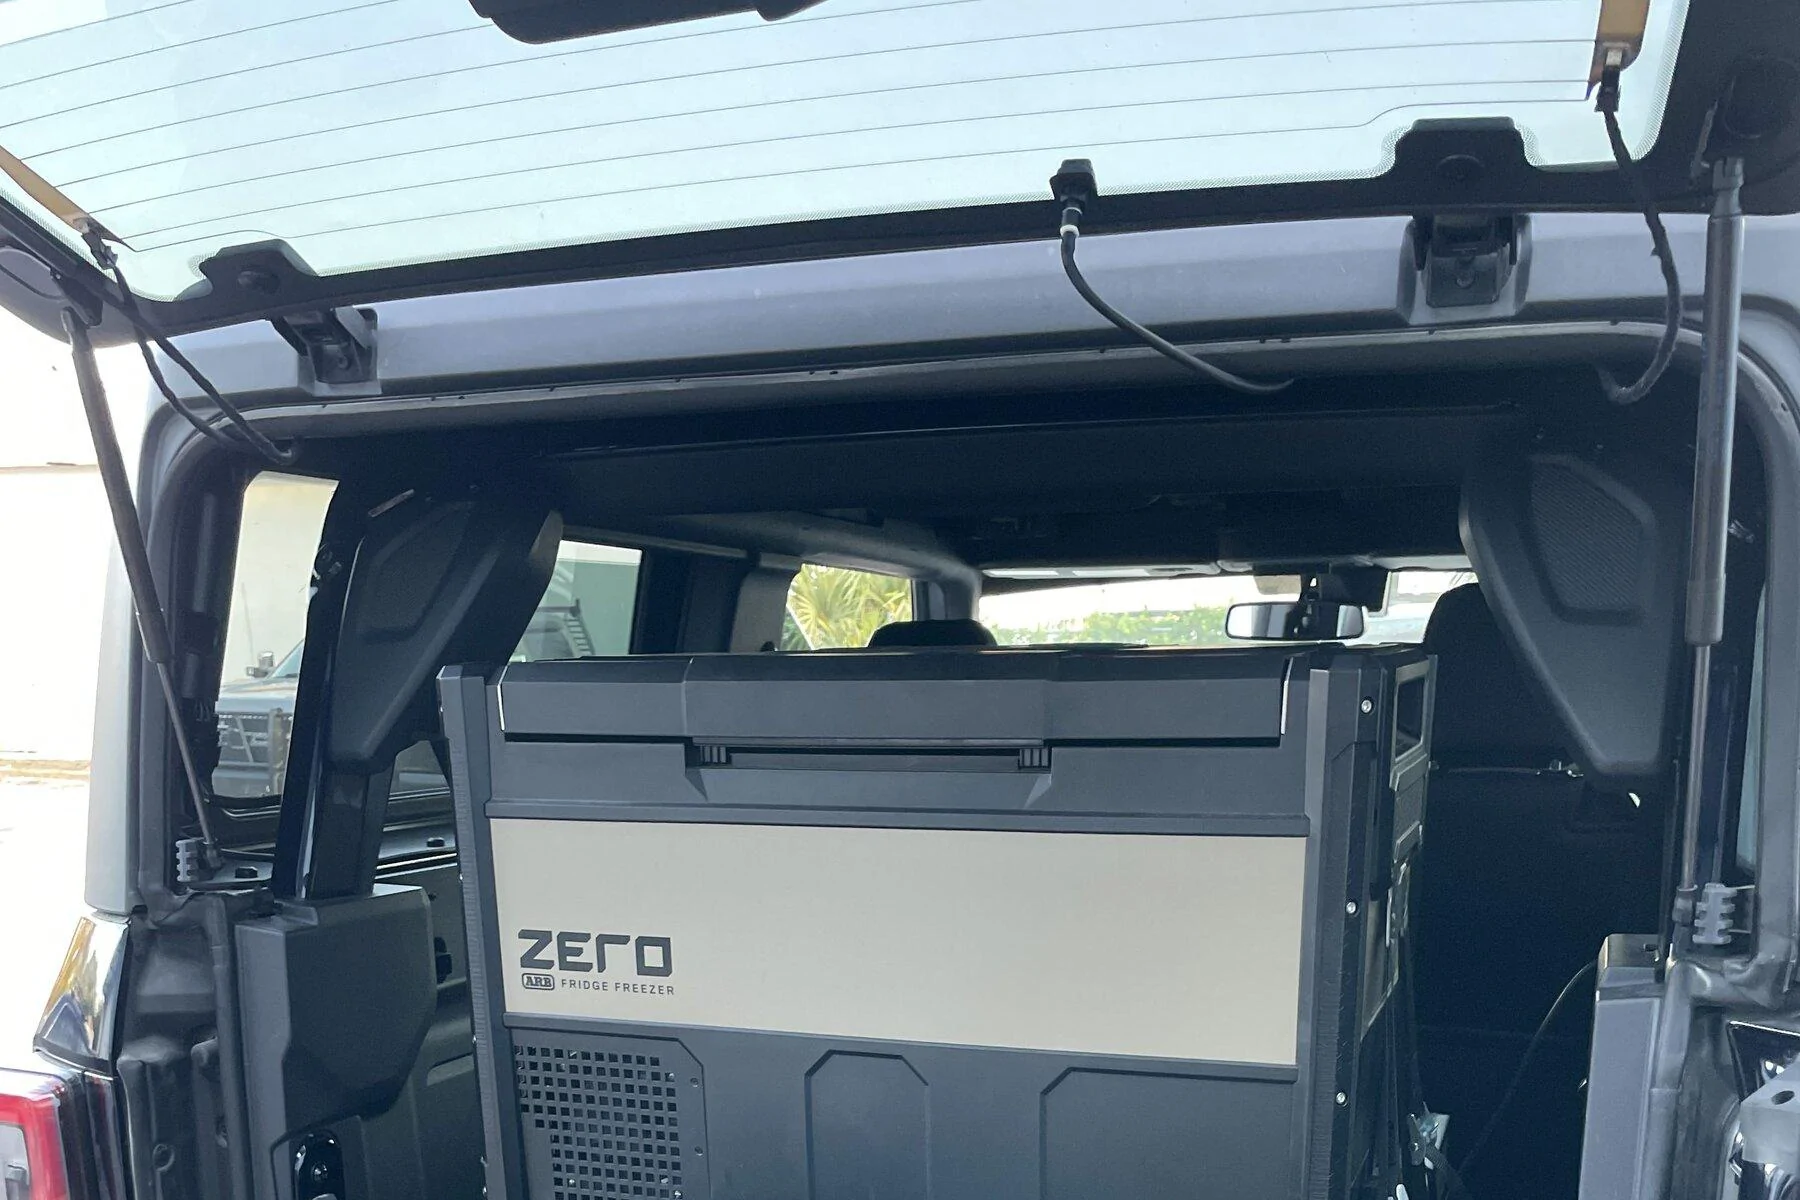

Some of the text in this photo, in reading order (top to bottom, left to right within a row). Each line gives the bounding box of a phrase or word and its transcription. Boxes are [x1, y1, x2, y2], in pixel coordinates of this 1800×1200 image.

[525, 975, 674, 996] ARB FRIDGE FREEZER
